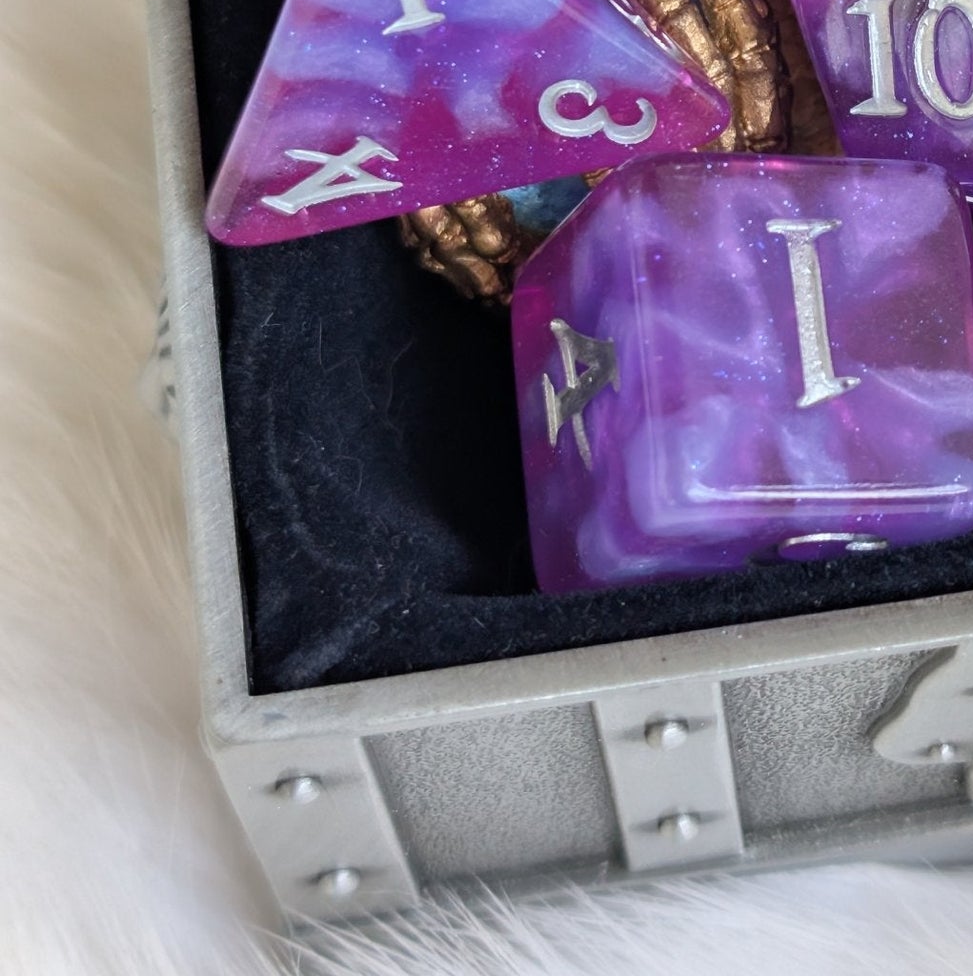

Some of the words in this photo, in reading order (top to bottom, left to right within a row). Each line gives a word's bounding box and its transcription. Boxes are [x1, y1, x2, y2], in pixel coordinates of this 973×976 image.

[538, 79, 658, 145] 3
[260, 136, 403, 215] 4
[766, 218, 862, 408] 1
[543, 318, 621, 471] 4
